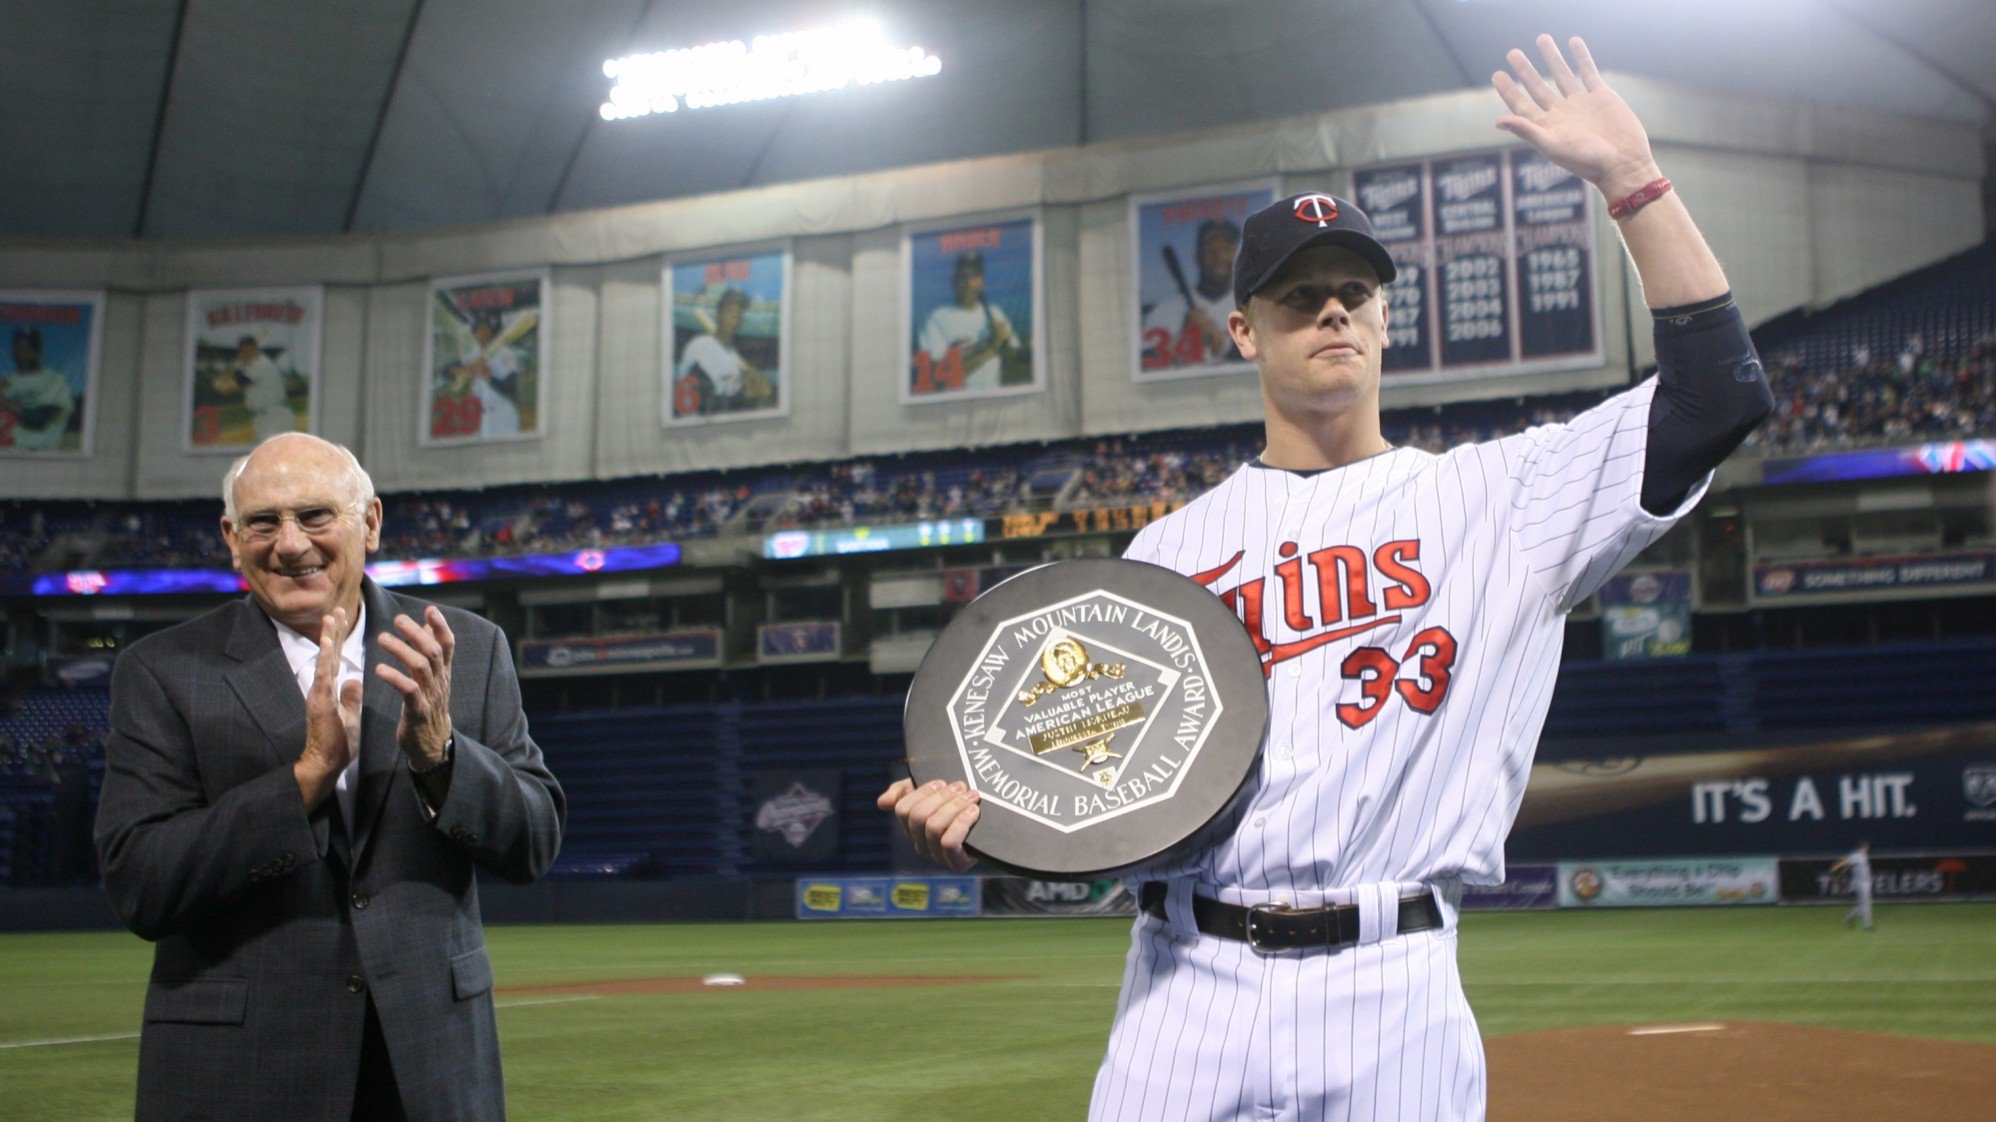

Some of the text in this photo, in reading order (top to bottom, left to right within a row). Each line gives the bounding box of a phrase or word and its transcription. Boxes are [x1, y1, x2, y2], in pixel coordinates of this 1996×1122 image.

[1446, 256, 1500, 279] 2002
[1531, 289, 1579, 313] 1991
[1141, 323, 1204, 369] 34
[911, 346, 965, 393] 14
[676, 374, 699, 414] 6
[193, 404, 221, 445] 3
[431, 395, 482, 437] 29
[1901, 560, 1985, 584] DIFFERENT
[963, 604, 1197, 740] KENESAW MOUNTAIN LANDIS
[1061, 685, 1092, 701] MOST
[1335, 625, 1459, 730] 33
[1016, 685, 1155, 740] AMERICAN LEAGUE
[1024, 681, 1136, 724] VALUABLE PLAYER
[968, 675, 1206, 816] MEMORIAL BASEBALL AWARD
[1692, 773, 1918, 825] IT'S A HIT.
[1026, 881, 1090, 902] AMD
